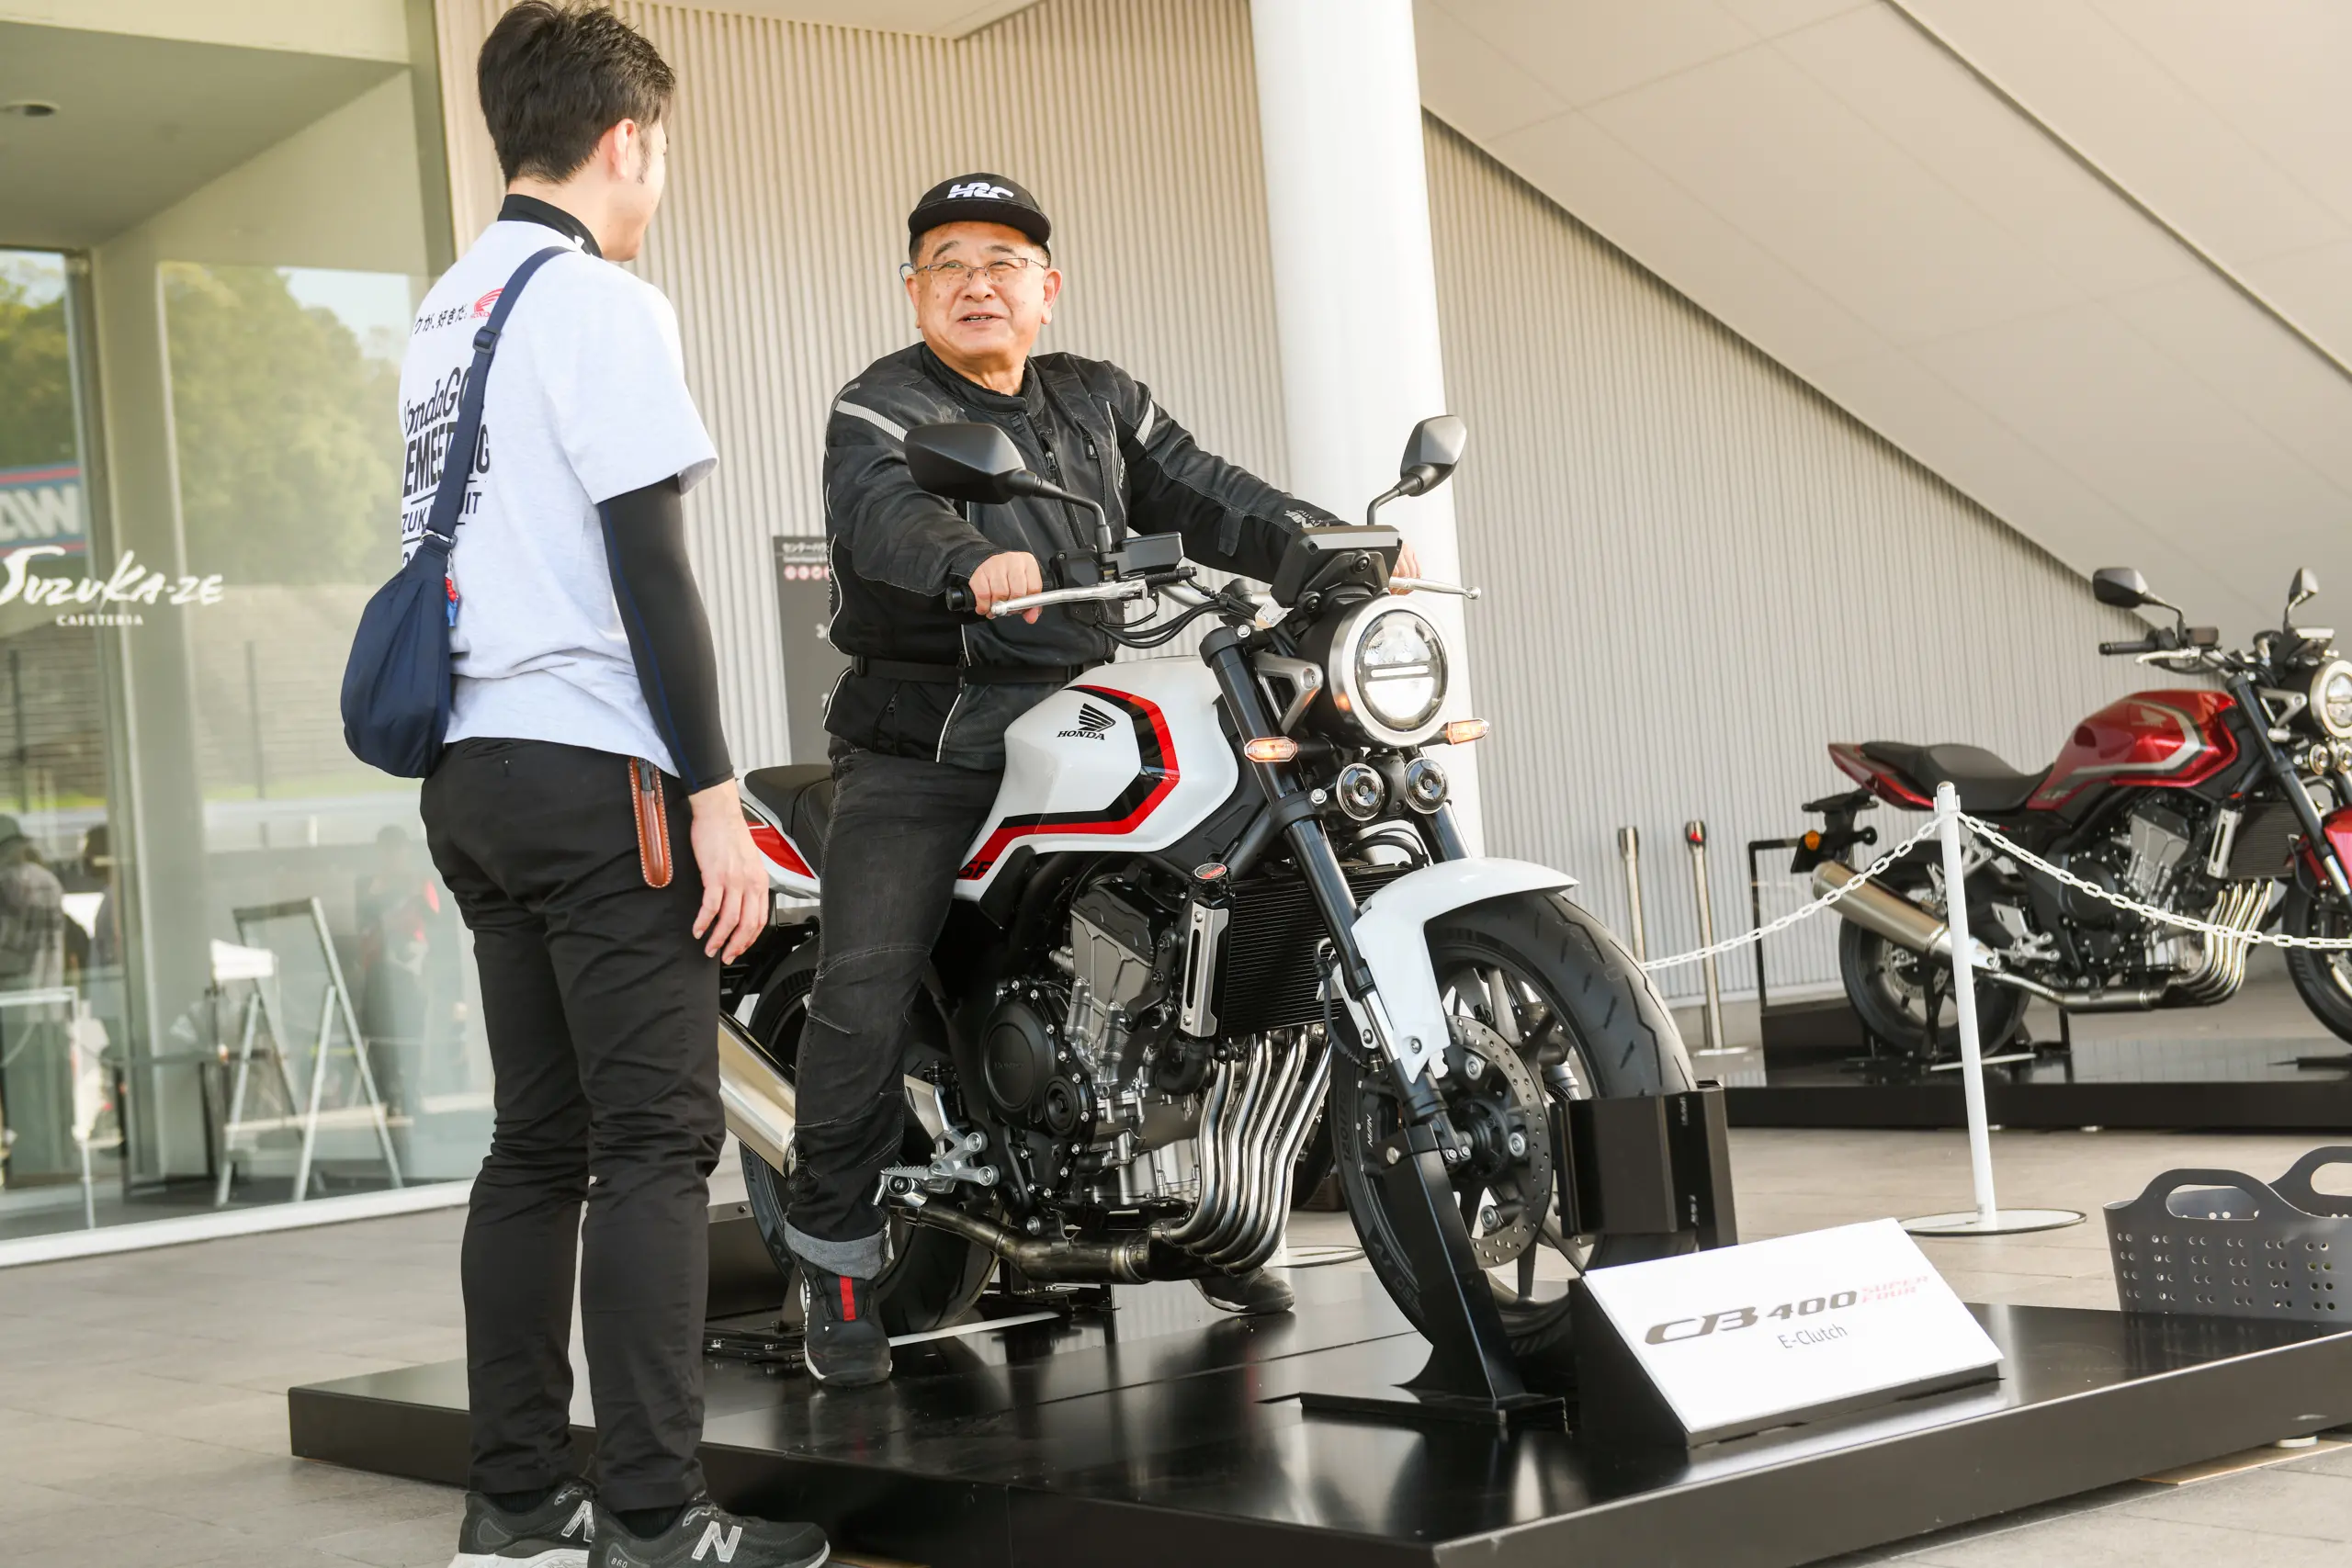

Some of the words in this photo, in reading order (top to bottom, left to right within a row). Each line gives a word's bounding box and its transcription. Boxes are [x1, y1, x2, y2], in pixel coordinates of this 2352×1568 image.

[947, 183, 1014, 198] HRC
[56, 614, 143, 626] CAFETERIA
[1057, 730, 1105, 740] HONDA
[1777, 1323, 1848, 1349] E-Clutch
[691, 1521, 742, 1562] N
[611, 1557, 628, 1568] 860
